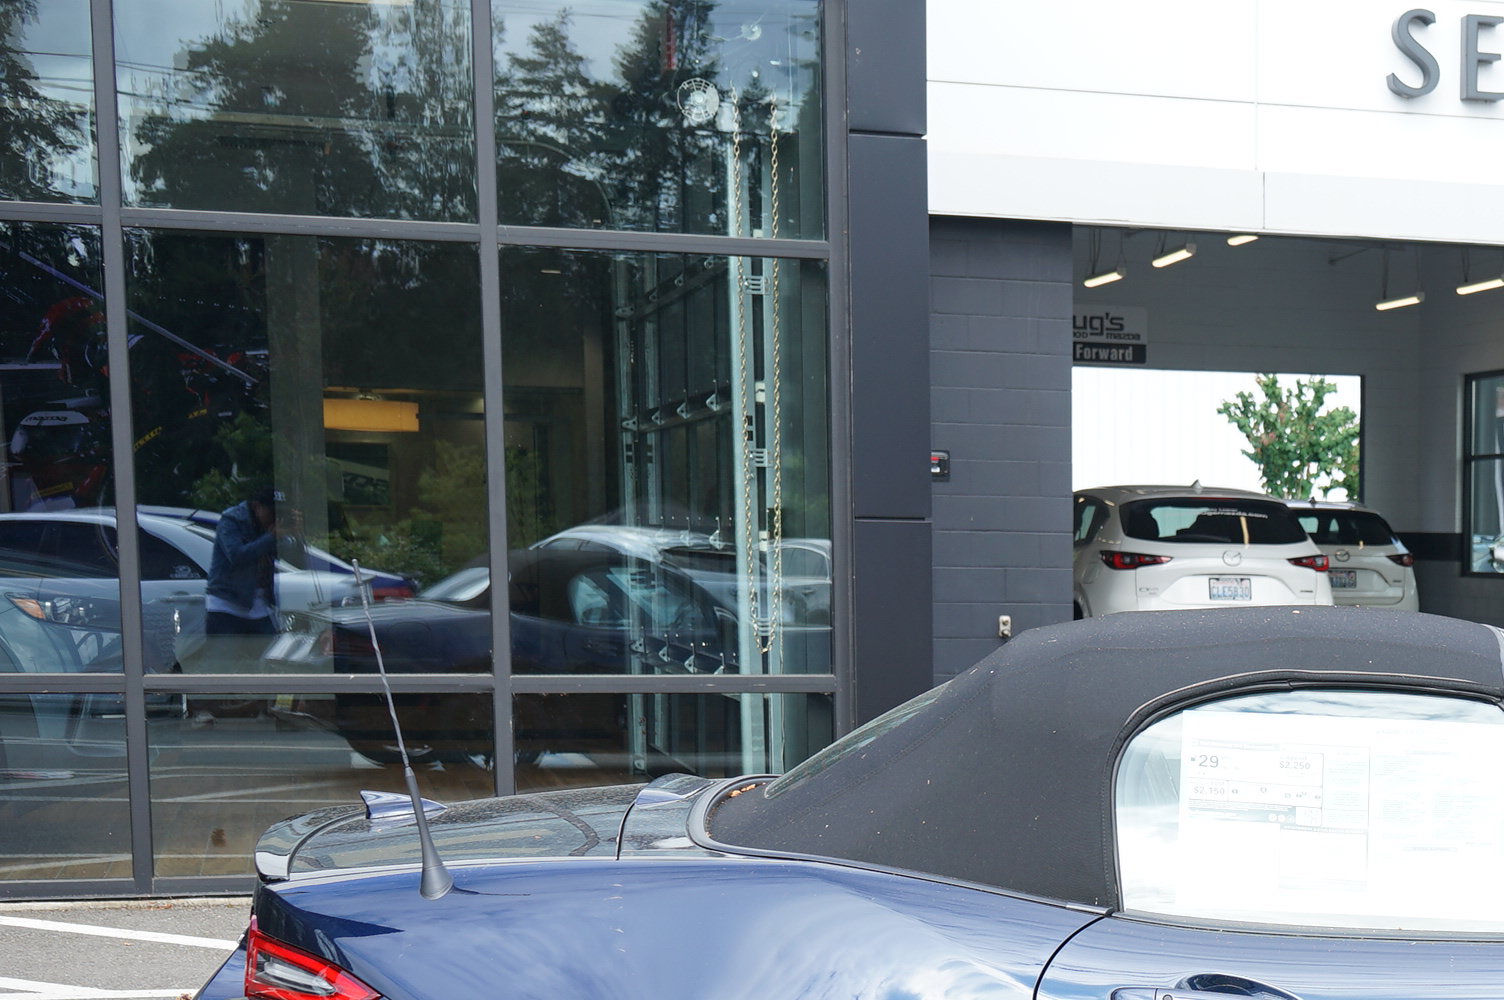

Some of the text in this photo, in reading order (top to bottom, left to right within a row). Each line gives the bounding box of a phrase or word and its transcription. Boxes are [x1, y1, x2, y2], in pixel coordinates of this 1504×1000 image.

[1073, 312, 1125, 336] ug's
[1076, 344, 1133, 361] Forward
[1199, 754, 1219, 768] 29
